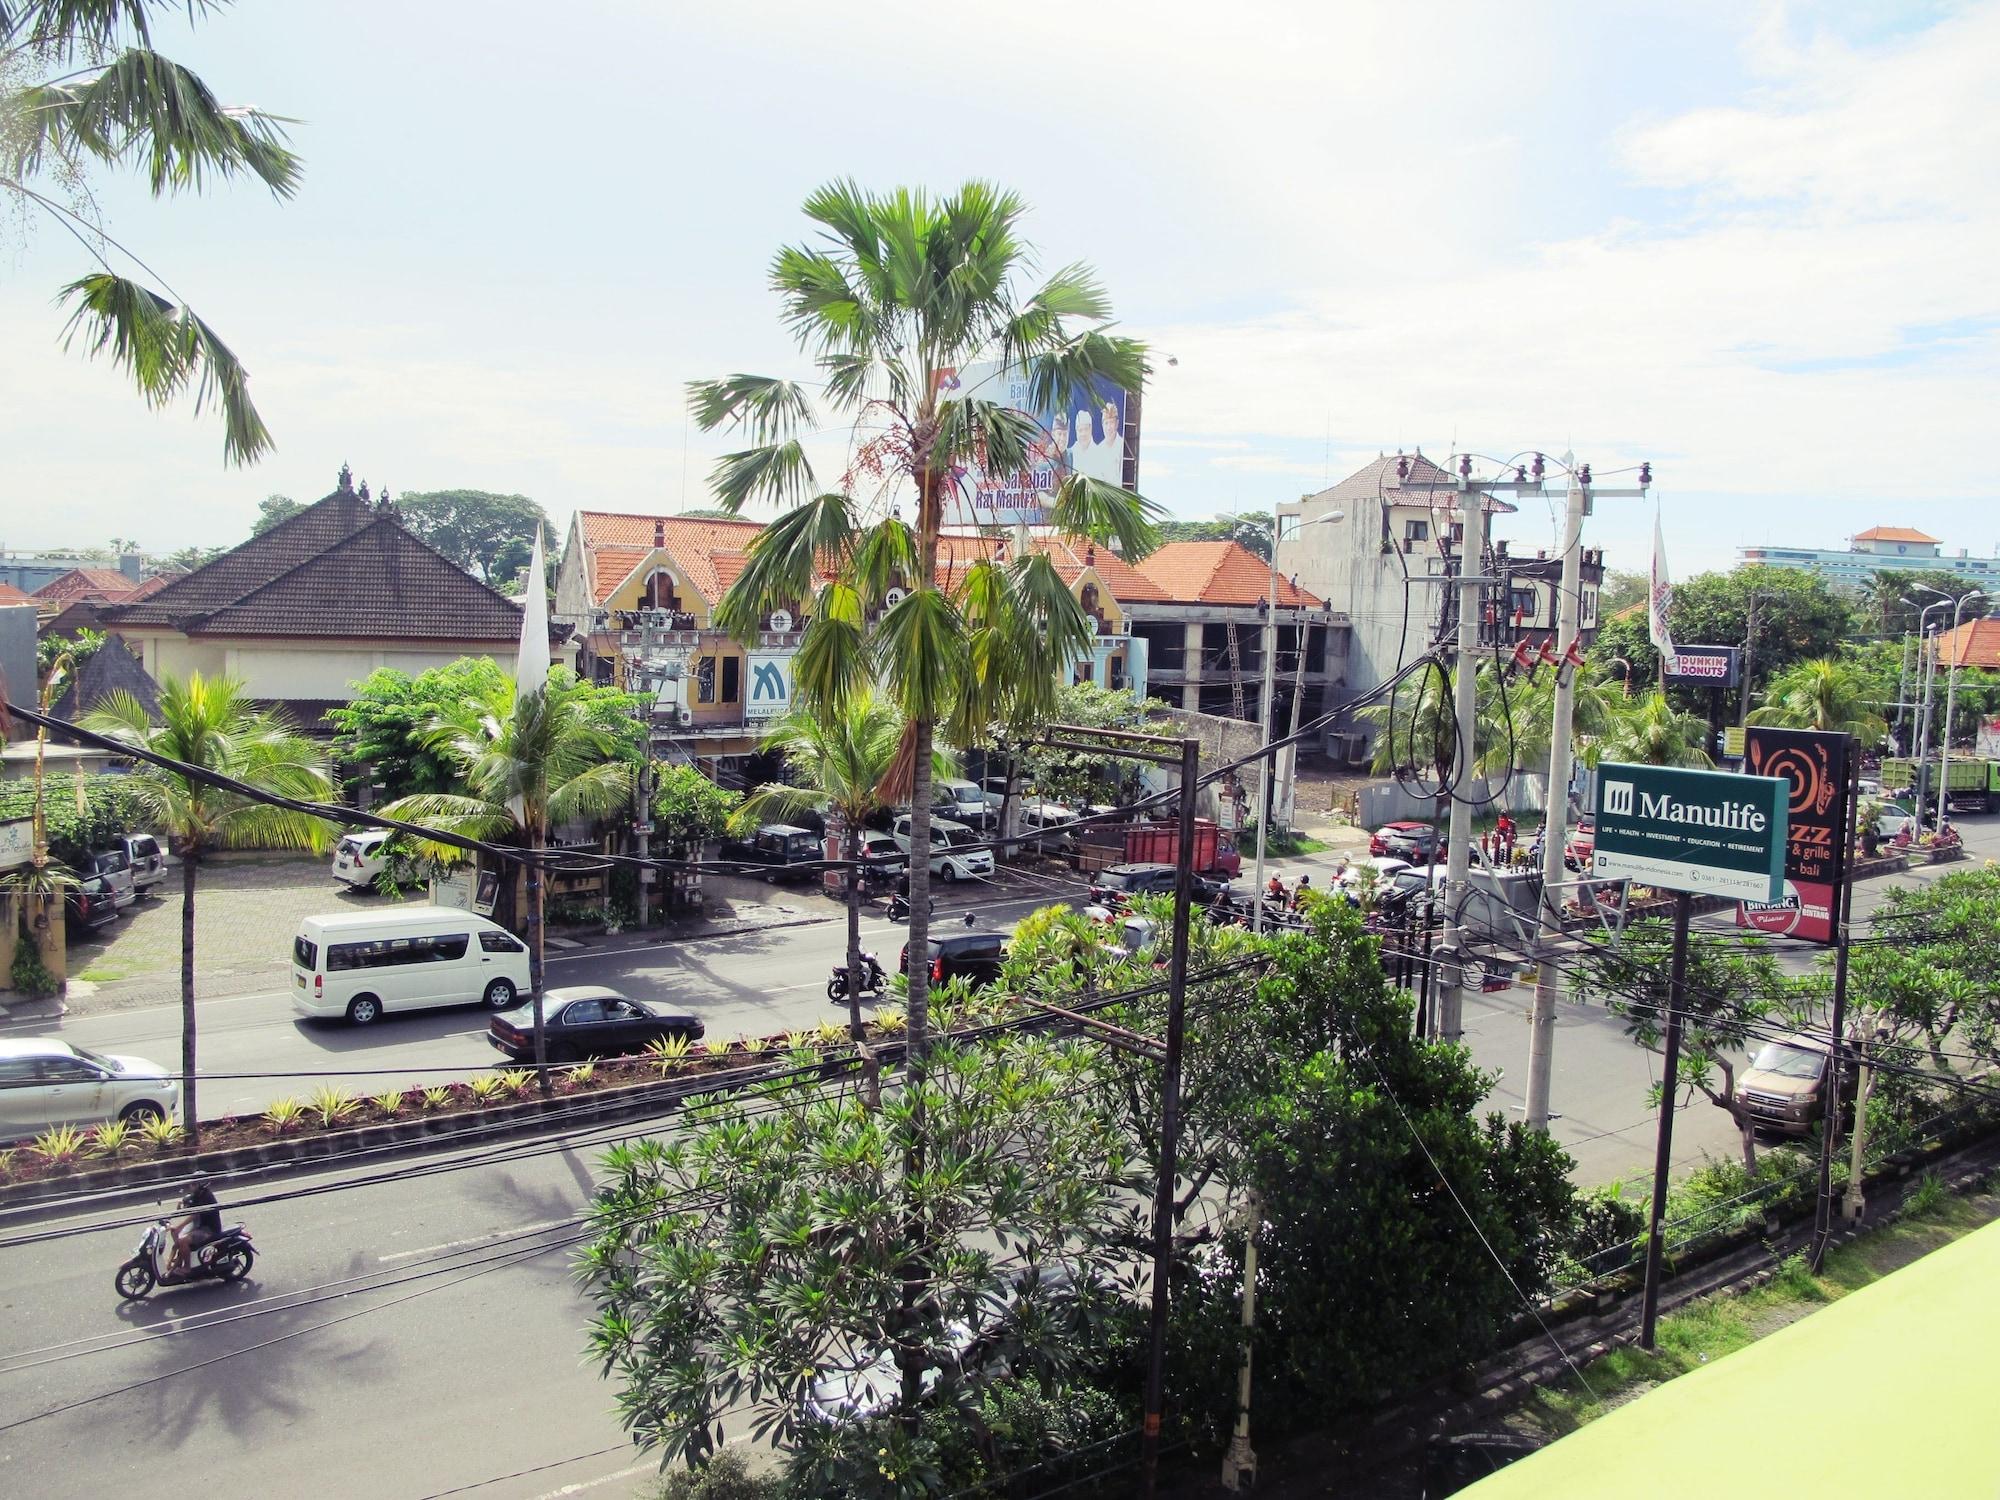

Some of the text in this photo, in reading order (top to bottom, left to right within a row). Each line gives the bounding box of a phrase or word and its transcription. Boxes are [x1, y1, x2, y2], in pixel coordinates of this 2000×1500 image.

[1681, 665, 1724, 676] DONUTS
[1638, 791, 1766, 833] Manulife
[1618, 828, 1640, 836] HEALTH
[1646, 832, 1681, 843] INVESTMENT
[1687, 837, 1721, 848] EDUCATION
[1727, 842, 1764, 853] RETIREMENT
[1792, 843, 1831, 860] & grille
[1800, 862, 1820, 876] bali
